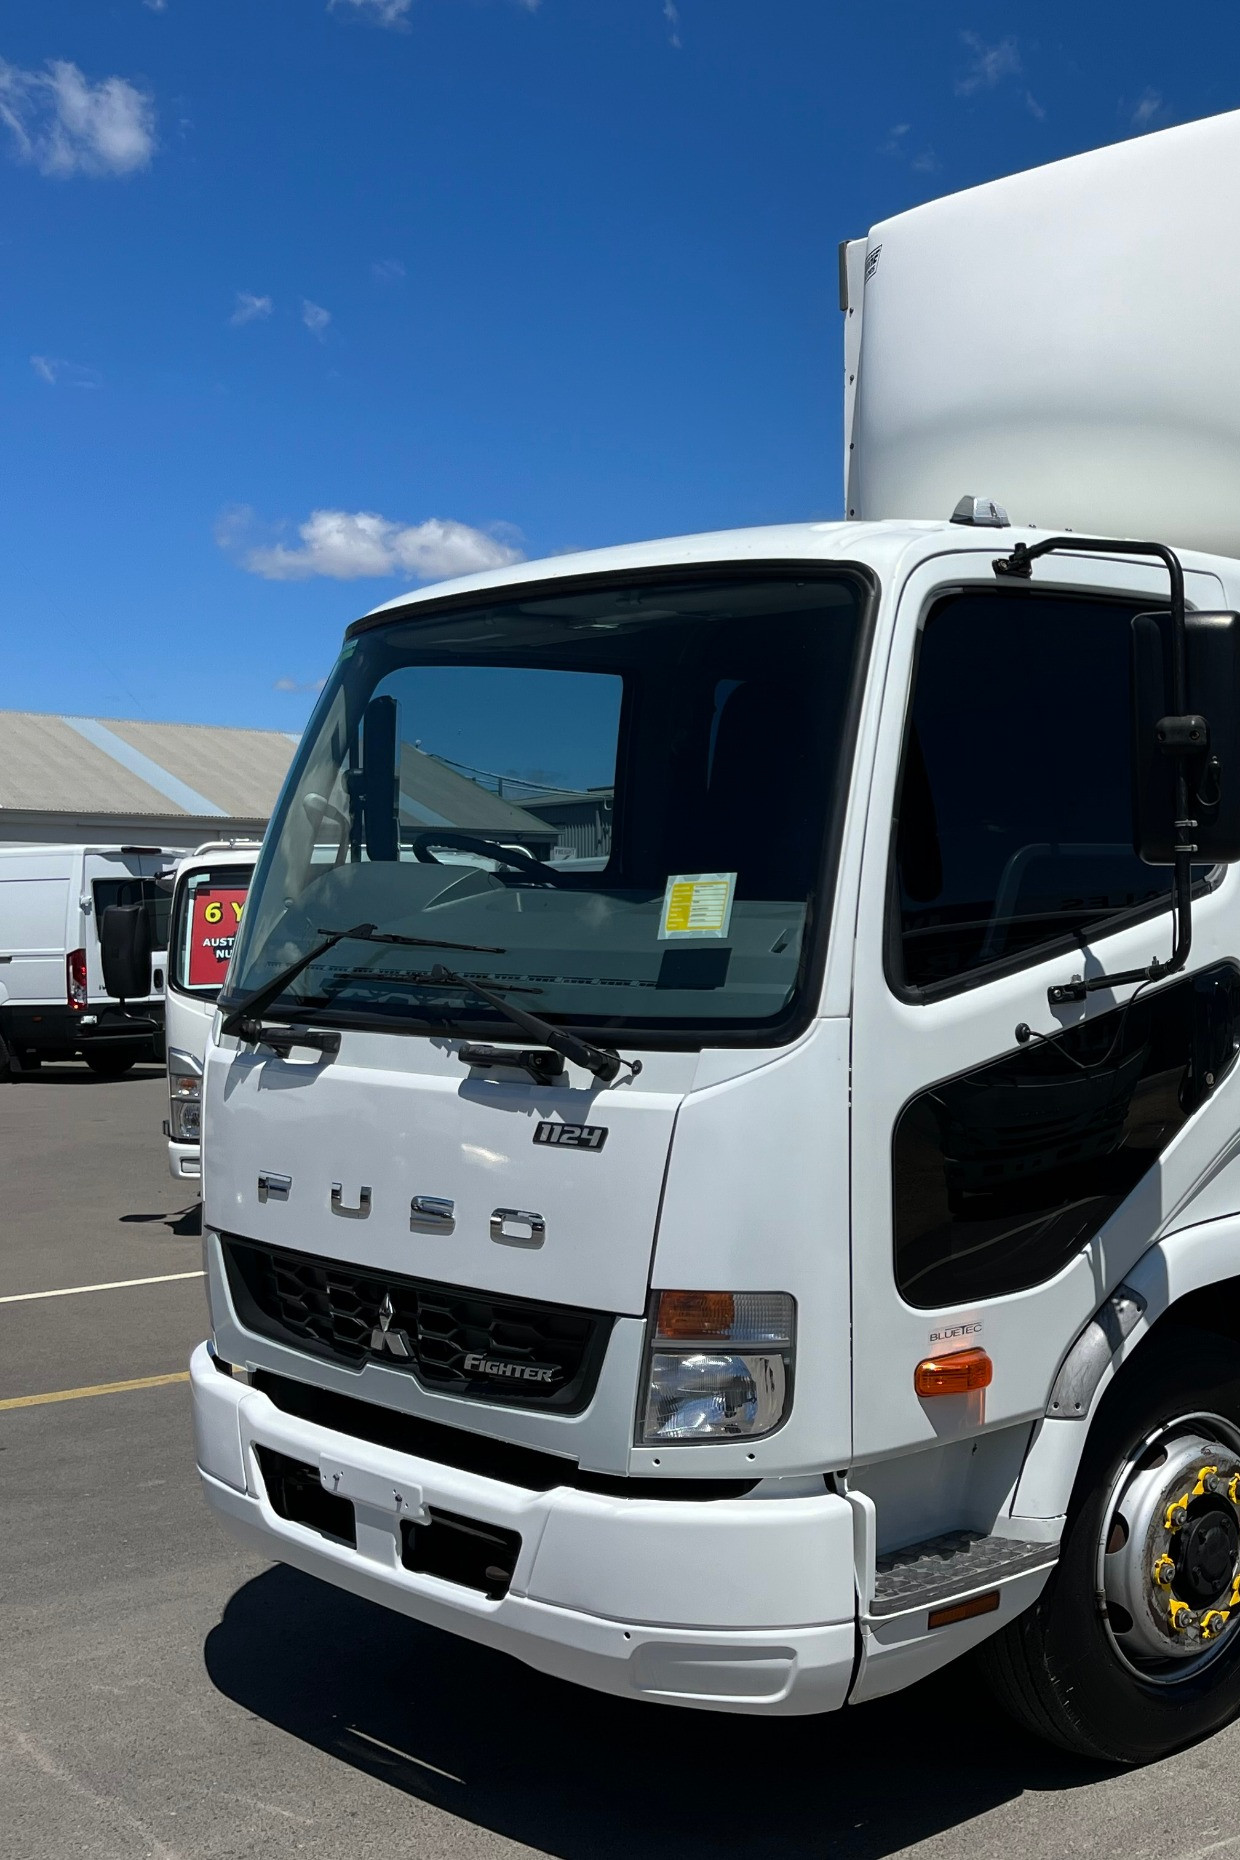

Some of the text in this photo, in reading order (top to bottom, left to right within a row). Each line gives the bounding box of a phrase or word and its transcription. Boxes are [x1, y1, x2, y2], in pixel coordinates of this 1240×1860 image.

[204, 901, 223, 923] 6
[539, 1123, 603, 1147] 1124
[258, 1169, 546, 1250] FUSO
[929, 1321, 983, 1342] BLUETEC
[463, 1352, 555, 1383] FIGHTER
